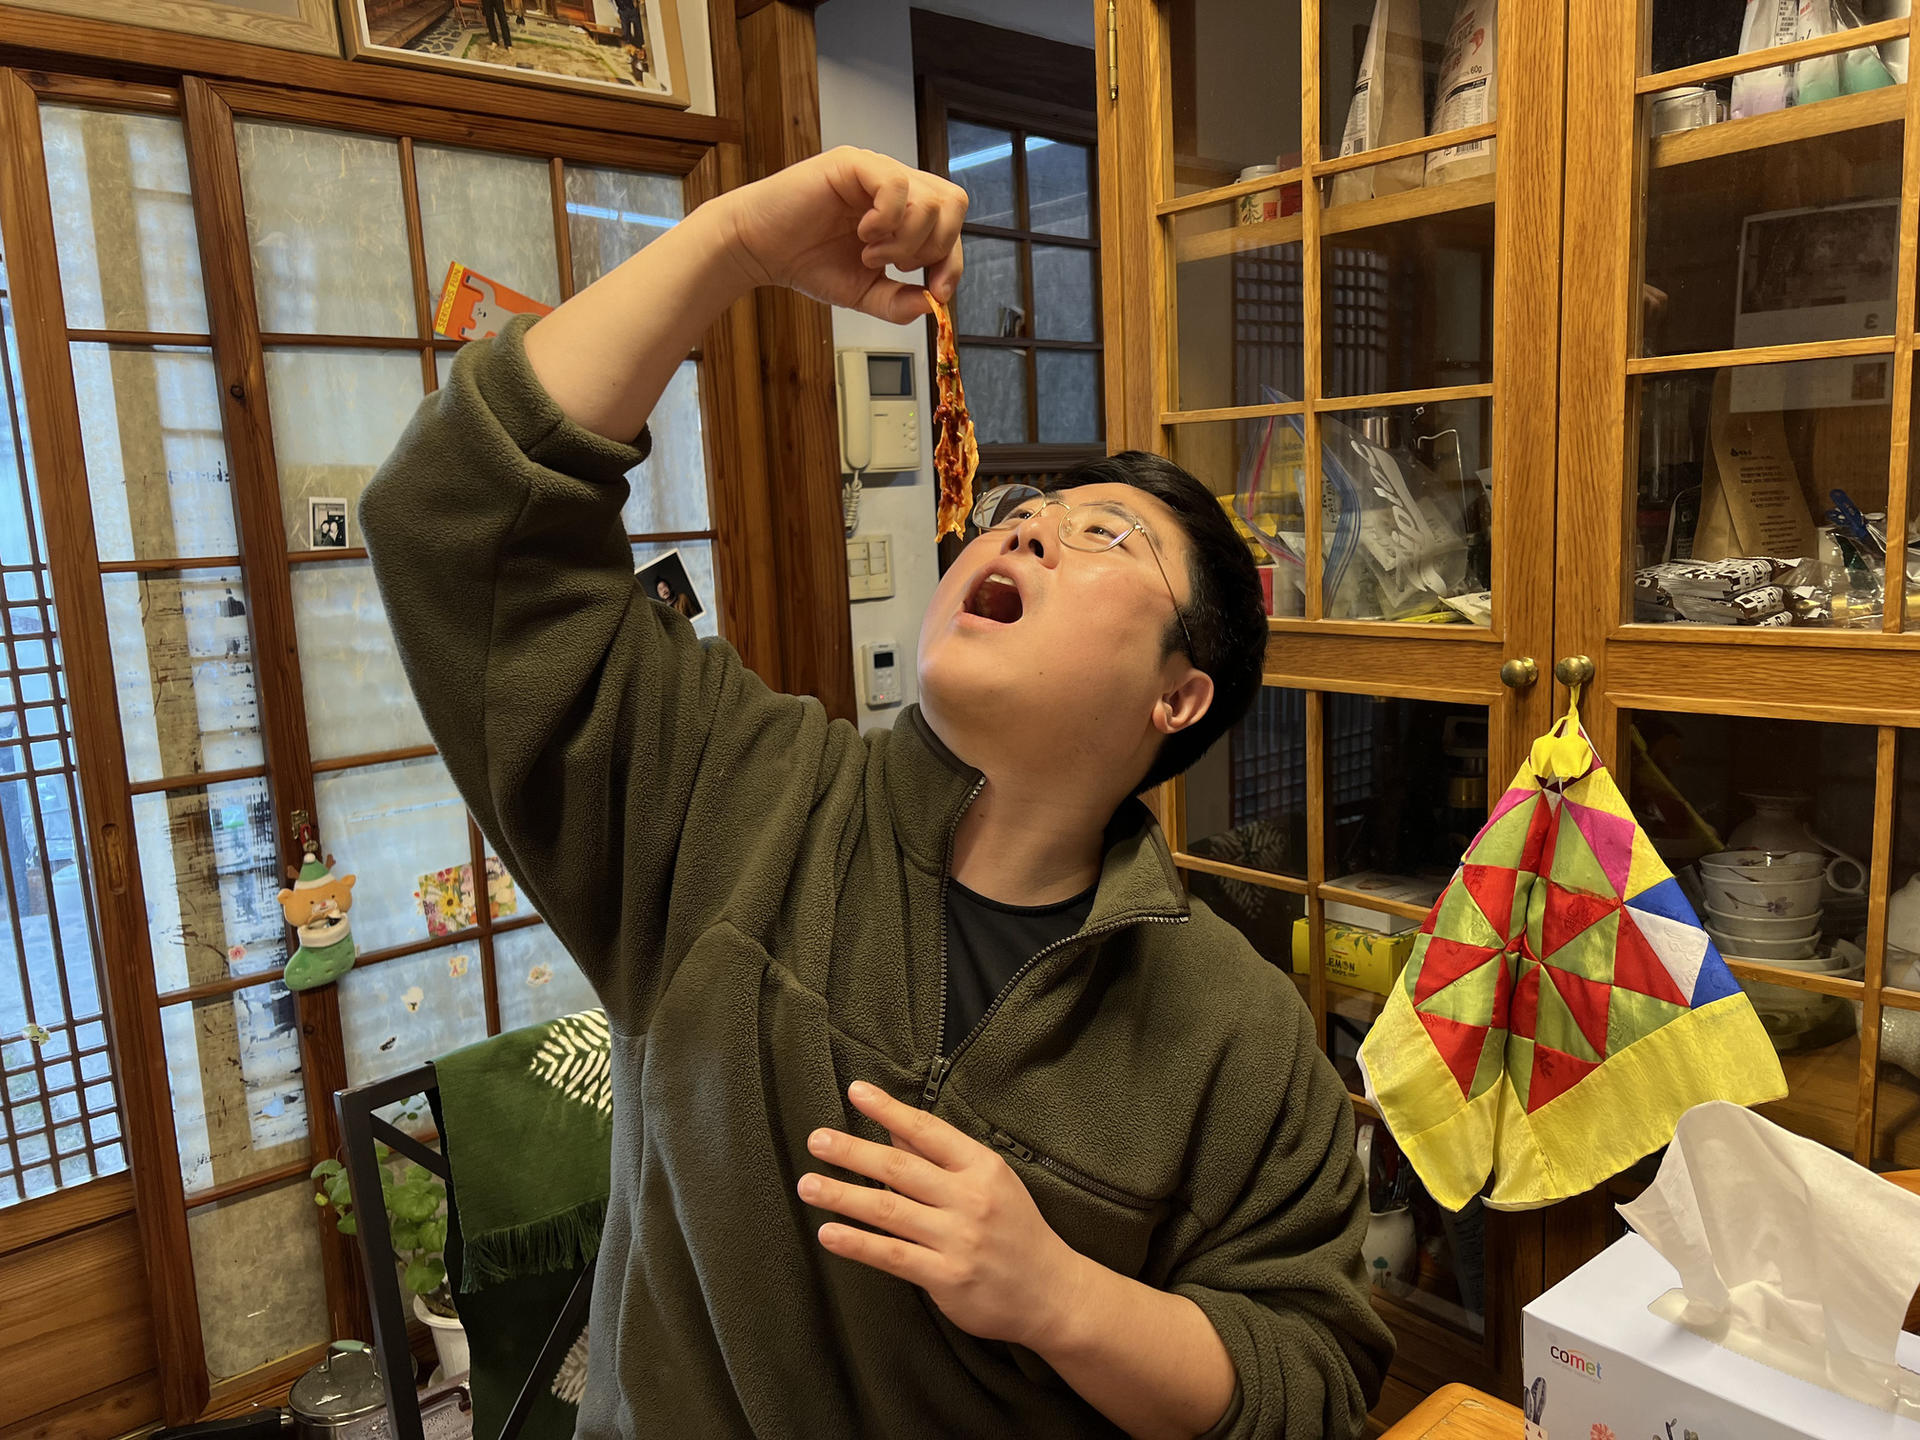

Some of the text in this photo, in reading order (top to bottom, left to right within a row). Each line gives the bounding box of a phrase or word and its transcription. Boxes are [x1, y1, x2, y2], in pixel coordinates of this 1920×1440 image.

[1470, 65, 1483, 74] 60g
[437, 268, 461, 328] SERIOUS FUN
[1550, 1345, 1602, 1380] comet
